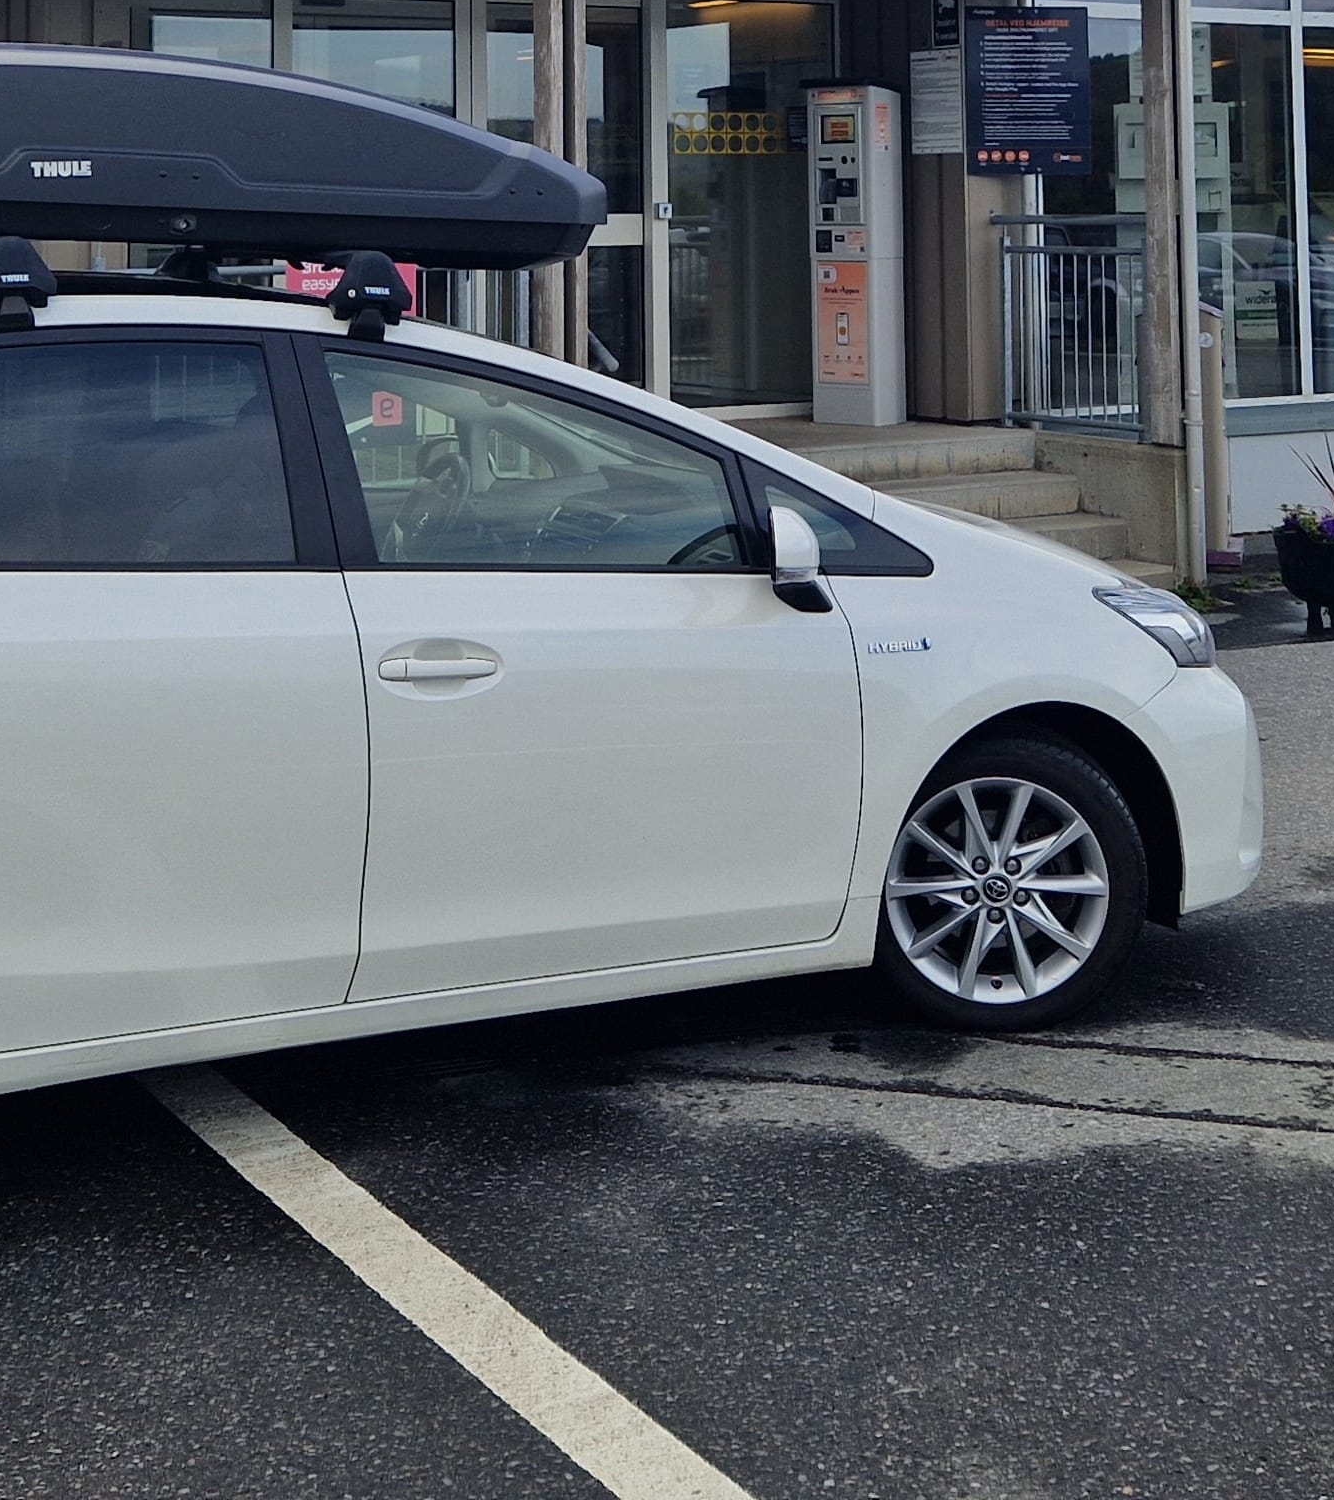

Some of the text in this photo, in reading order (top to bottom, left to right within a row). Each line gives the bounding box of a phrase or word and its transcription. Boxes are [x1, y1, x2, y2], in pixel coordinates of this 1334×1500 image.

[30, 160, 92, 177] THULE
[0, 273, 30, 283] THULE
[364, 286, 390, 296] THULE
[868, 639, 923, 654] HYBRID
